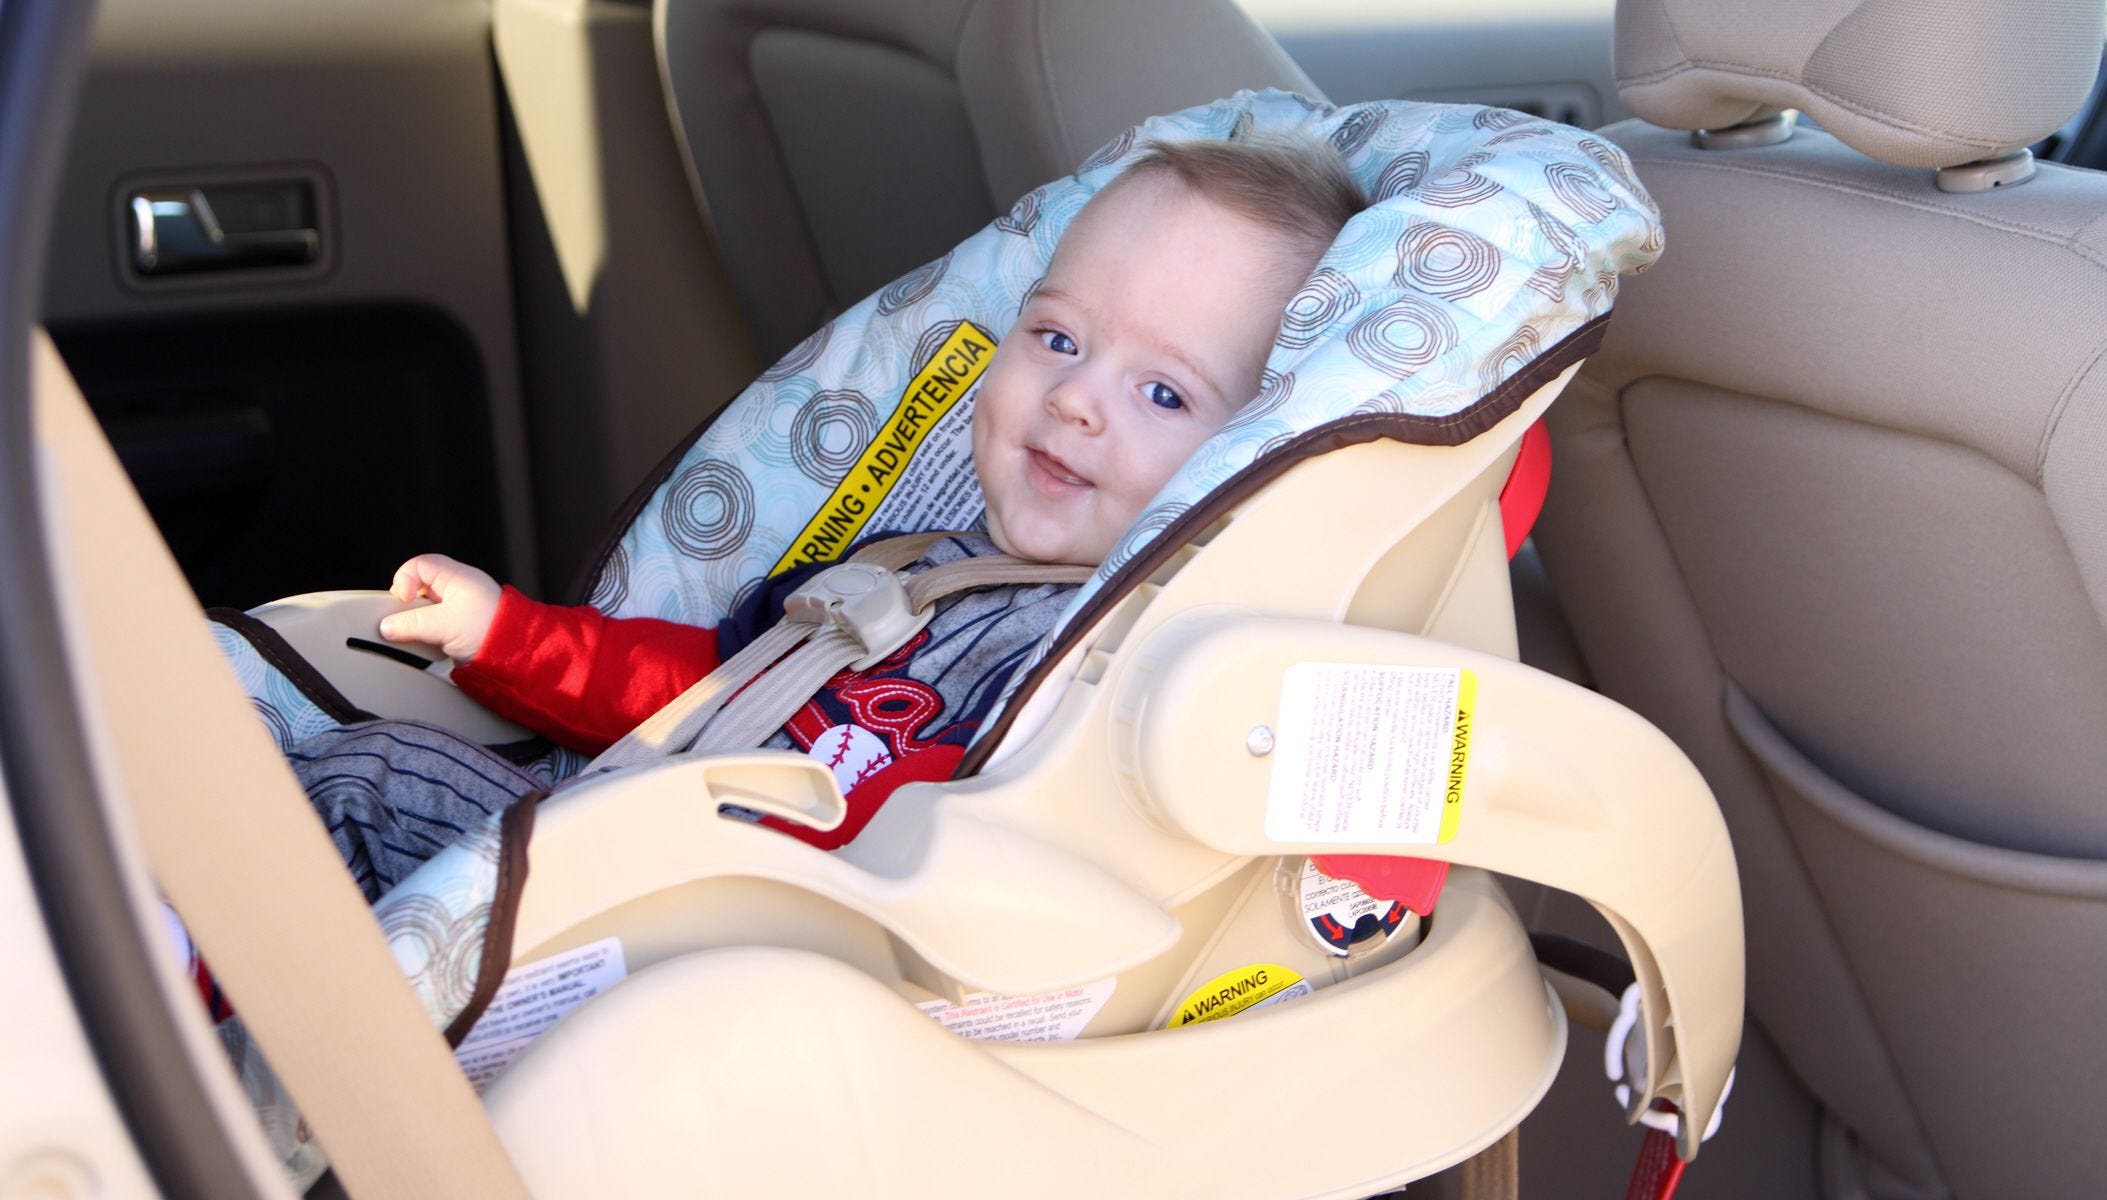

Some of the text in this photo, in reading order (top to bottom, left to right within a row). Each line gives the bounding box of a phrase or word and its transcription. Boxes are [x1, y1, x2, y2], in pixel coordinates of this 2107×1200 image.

[787, 337, 988, 562] RNING ADVERTENCIA
[880, 477, 911, 515] rear-facing
[907, 456, 922, 476] child
[919, 441, 933, 457] seat
[931, 432, 940, 442] on
[938, 415, 955, 432] front
[954, 401, 969, 417] seat
[900, 494, 923, 524] children
[920, 483, 930, 493] 12
[927, 468, 940, 483] and
[938, 449, 957, 469] under.
[904, 471, 925, 499] INJURY
[923, 456, 935, 471] can
[933, 436, 952, 457] occur.
[950, 423, 965, 436] The
[942, 490, 972, 526] LESIONES
[1446, 724, 1468, 804] WARNING
[1304, 891, 1350, 912] SOLAMENTE
[1194, 969, 1268, 1016] WARNING
